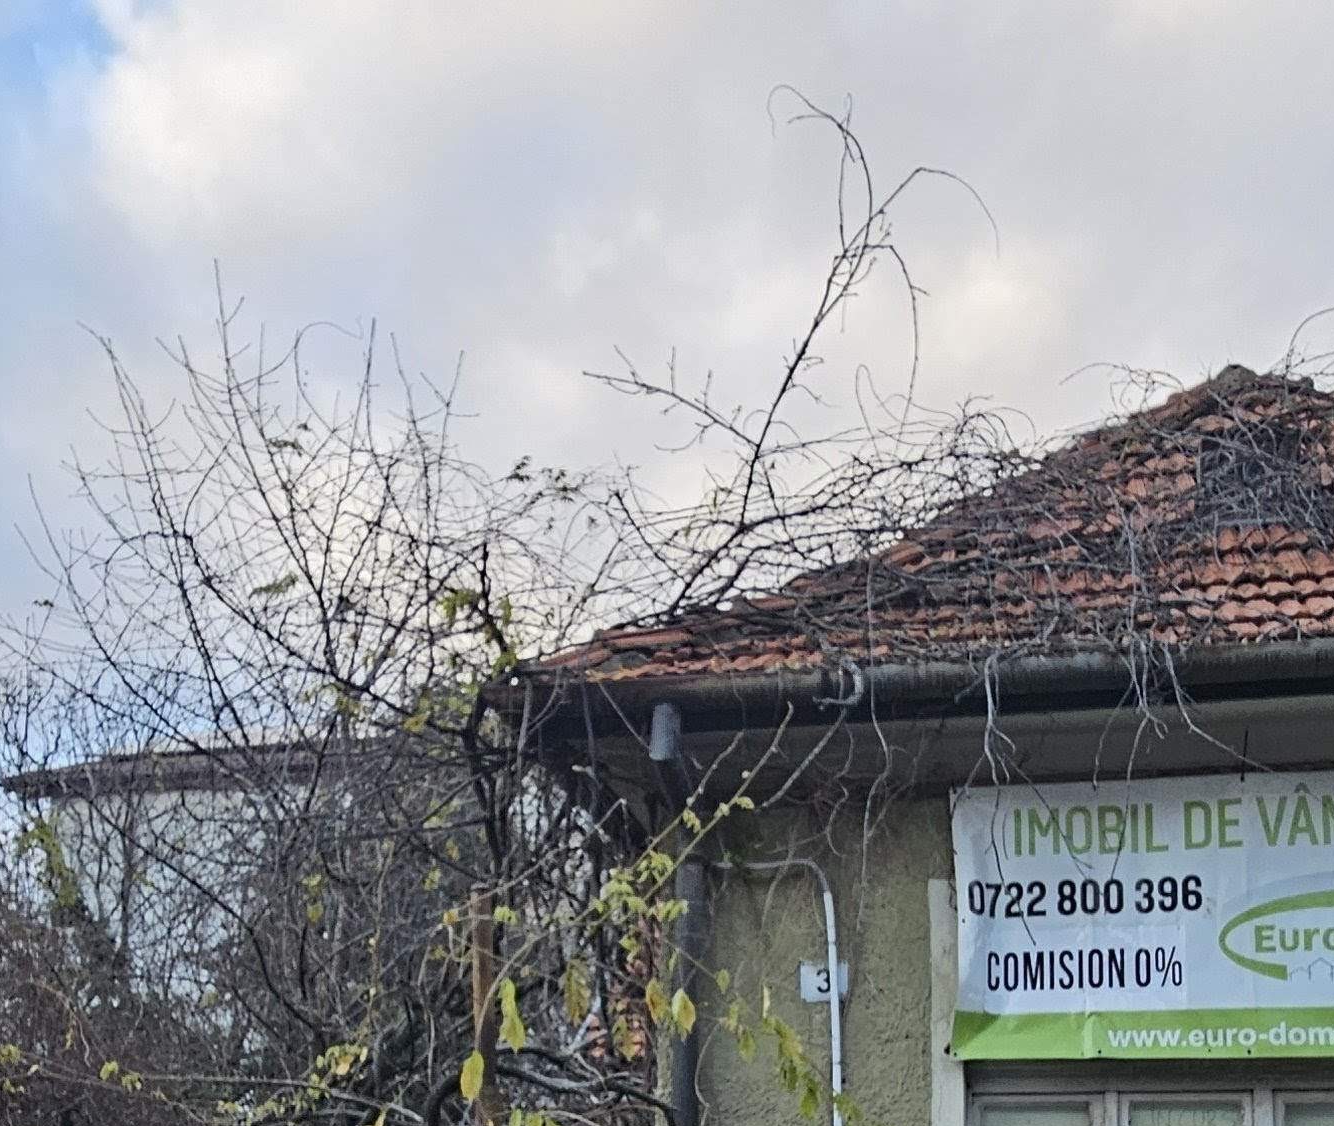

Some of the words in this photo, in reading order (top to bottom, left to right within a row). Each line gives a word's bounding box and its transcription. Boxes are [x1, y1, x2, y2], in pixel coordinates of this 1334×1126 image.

[1014, 803, 1168, 855] IMOBIL
[1184, 799, 1242, 848] DE
[968, 880, 1047, 918] 0722
[1057, 878, 1125, 915] 800
[1134, 875, 1204, 912] 396
[817, 968, 830, 992] 3
[987, 948, 1126, 992] COMISION
[1135, 945, 1183, 988] 0%
